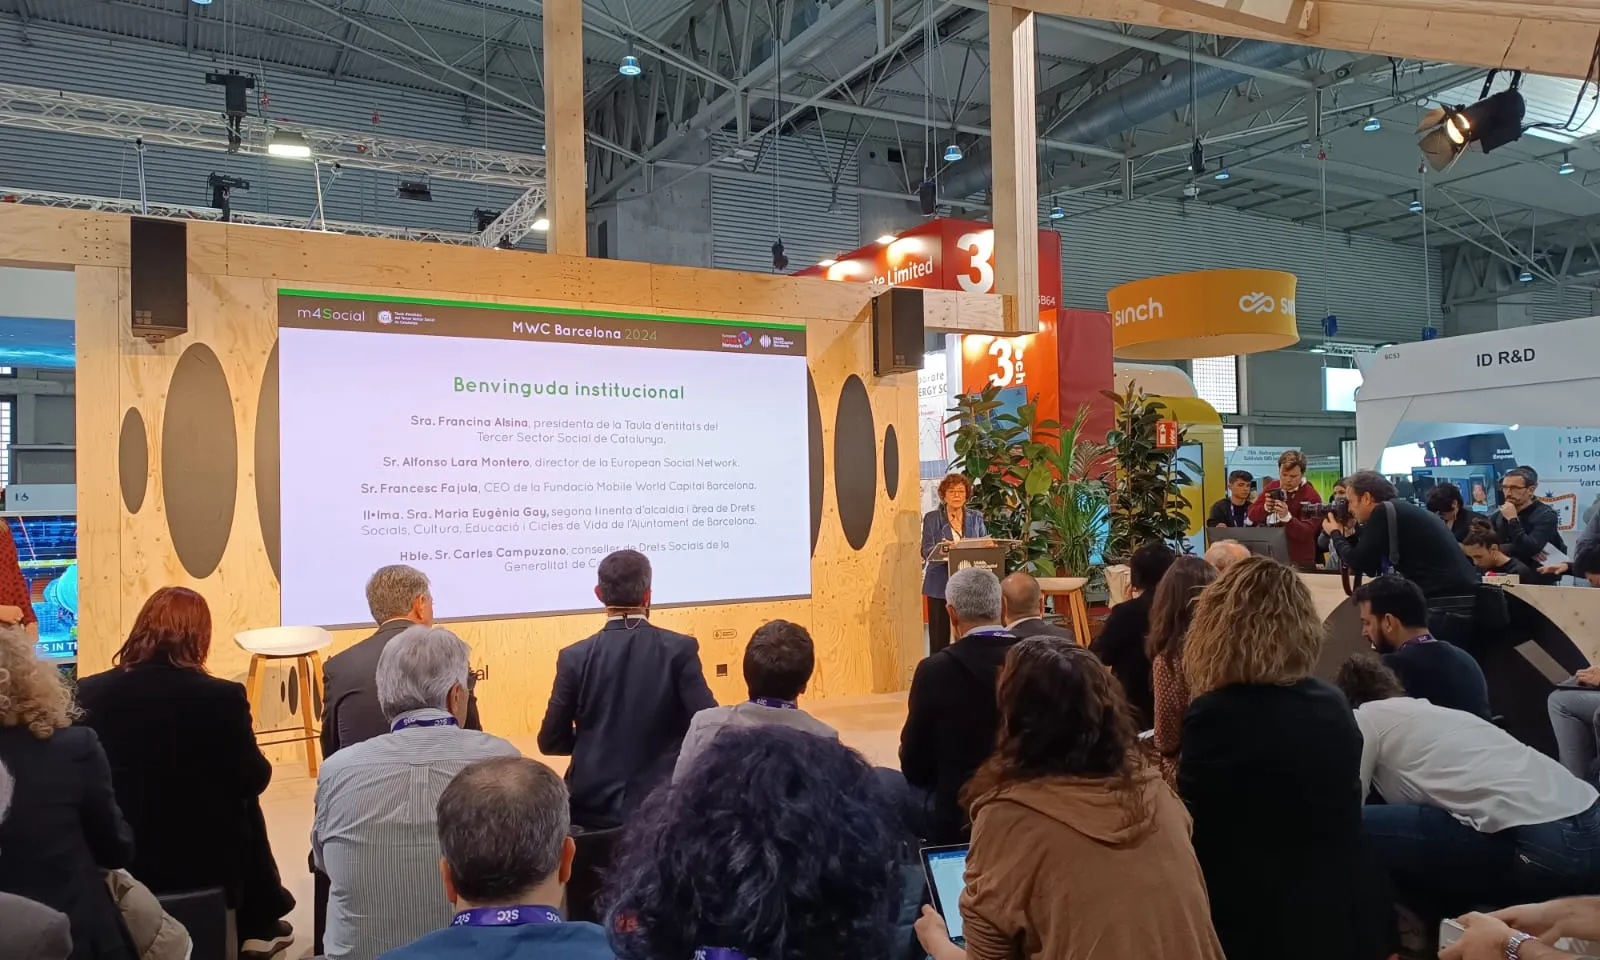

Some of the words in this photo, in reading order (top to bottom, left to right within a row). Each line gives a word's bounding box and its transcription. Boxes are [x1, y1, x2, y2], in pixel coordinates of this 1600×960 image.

[887, 256, 933, 287] Limited
[957, 231, 994, 294] 3
[297, 307, 365, 322] m4Social
[1116, 298, 1164, 327] sinch
[512, 321, 551, 335] MWC
[554, 324, 622, 340] Barcelona
[625, 329, 657, 341] 2024
[988, 339, 1014, 387] 3
[1476, 354, 1493, 367] ID
[1499, 348, 1536, 364] R&D
[453, 377, 569, 398] Benvinguda
[575, 381, 685, 399] institucional
[411, 415, 436, 426] Sra.
[438, 416, 492, 427] Francina
[494, 417, 531, 429] Alsina,
[533, 418, 595, 430] presidenta
[596, 419, 610, 429] de
[612, 420, 622, 430] la
[625, 420, 652, 430] Taula
[704, 423, 718, 431] del
[477, 432, 514, 442] Tercer
[517, 432, 555, 443] Sector
[557, 432, 592, 444] Social
[594, 433, 608, 444] de
[610, 433, 667, 447] Catalunya.
[383, 456, 400, 467] Sr.
[402, 456, 448, 467] Alfonso
[451, 456, 478, 467] Lara
[481, 456, 533, 468] Montero,
[535, 457, 579, 468] director
[583, 458, 596, 468] de
[600, 458, 608, 468] la
[611, 458, 661, 469] European
[664, 458, 695, 468] Social
[697, 458, 741, 468] Network.
[360, 483, 378, 494] Sr.
[380, 483, 438, 493] Francesc
[441, 483, 481, 495] Fajula,
[484, 482, 511, 493] CEO
[513, 482, 528, 492] de
[531, 482, 541, 492] la
[544, 481, 594, 492] Fundació
[597, 481, 633, 492] Mobile
[636, 481, 666, 492] World
[669, 481, 704, 493] Capital
[707, 480, 757, 491] Barcelona.
[407, 509, 432, 520] Sra.
[435, 508, 469, 518] Maria
[472, 507, 520, 520] Eugènia
[523, 507, 550, 519] Gay,
[551, 507, 591, 518] segona
[595, 505, 632, 516] tinenta
[692, 503, 714, 514] àrea
[716, 503, 728, 513] de
[731, 503, 756, 512] Drets
[361, 525, 411, 536] Socials,
[413, 523, 462, 535] Cultura,
[465, 522, 520, 533] Educació
[529, 521, 564, 532] Cicles
[566, 520, 581, 530] de
[584, 520, 608, 530] Vida
[611, 519, 624, 529] de
[692, 518, 705, 527] de
[707, 517, 757, 527] Barcelona.
[400, 551, 433, 561] Hble.
[435, 550, 451, 560] Sr.
[453, 549, 493, 559] Carles
[496, 547, 569, 559] Campuzano,
[639, 542, 666, 552] Drets
[669, 541, 704, 551] Socials
[706, 540, 719, 550] de
[720, 540, 730, 550] la
[504, 560, 568, 573] Generalitat
[572, 559, 586, 570] de
[52, 642, 64, 651] IN
[497, 909, 520, 923] stc
